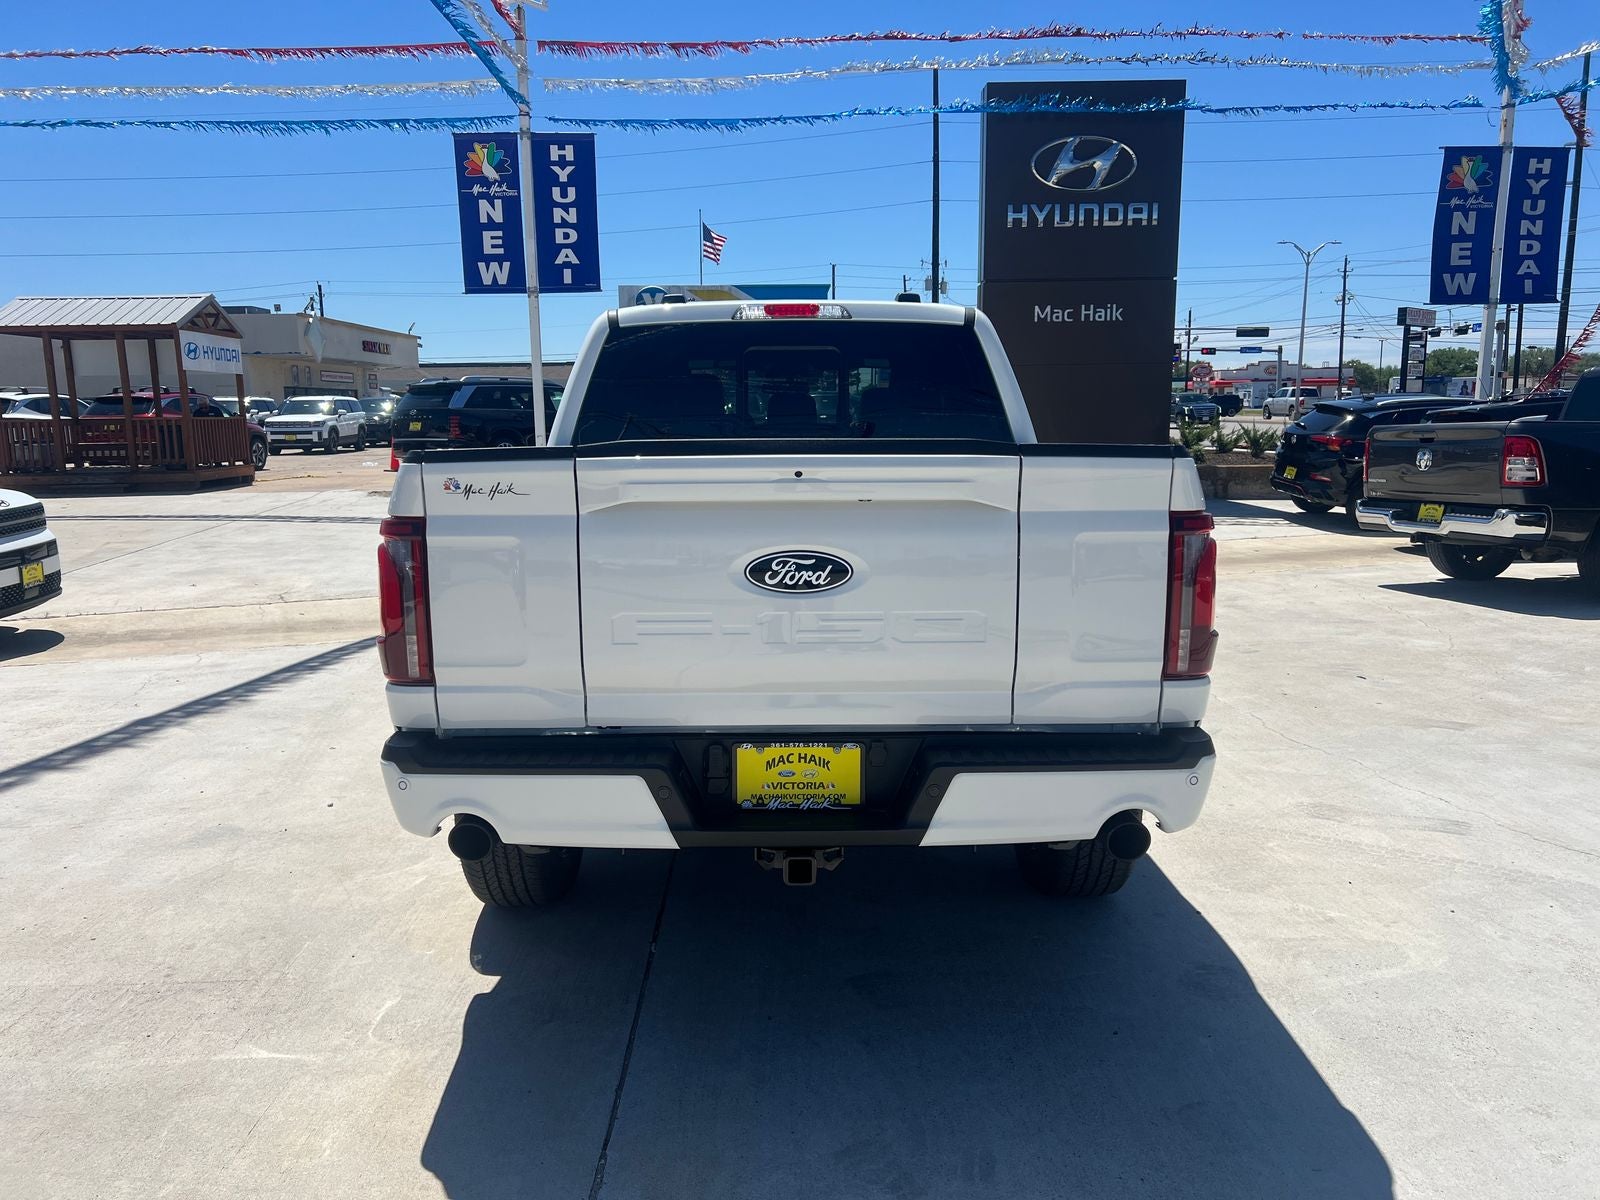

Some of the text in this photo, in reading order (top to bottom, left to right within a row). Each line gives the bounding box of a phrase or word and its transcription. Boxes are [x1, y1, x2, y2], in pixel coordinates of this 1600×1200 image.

[550, 144, 580, 284] HYUNDAI
[1007, 202, 1159, 228] HYUNDAI
[1517, 158, 1552, 294] HYUNDAI
[477, 199, 511, 285] NEW
[1443, 211, 1477, 295] NEW
[1034, 304, 1124, 322] Mac Haik
[203, 345, 240, 363] HYUNDAI
[461, 482, 522, 500] Mac Haik
[764, 557, 832, 585] Ford
[611, 611, 987, 645] F-150
[765, 753, 831, 771] MAC HAIK
[771, 781, 826, 790] VICTORIA
[766, 797, 836, 810] Mac Haik
